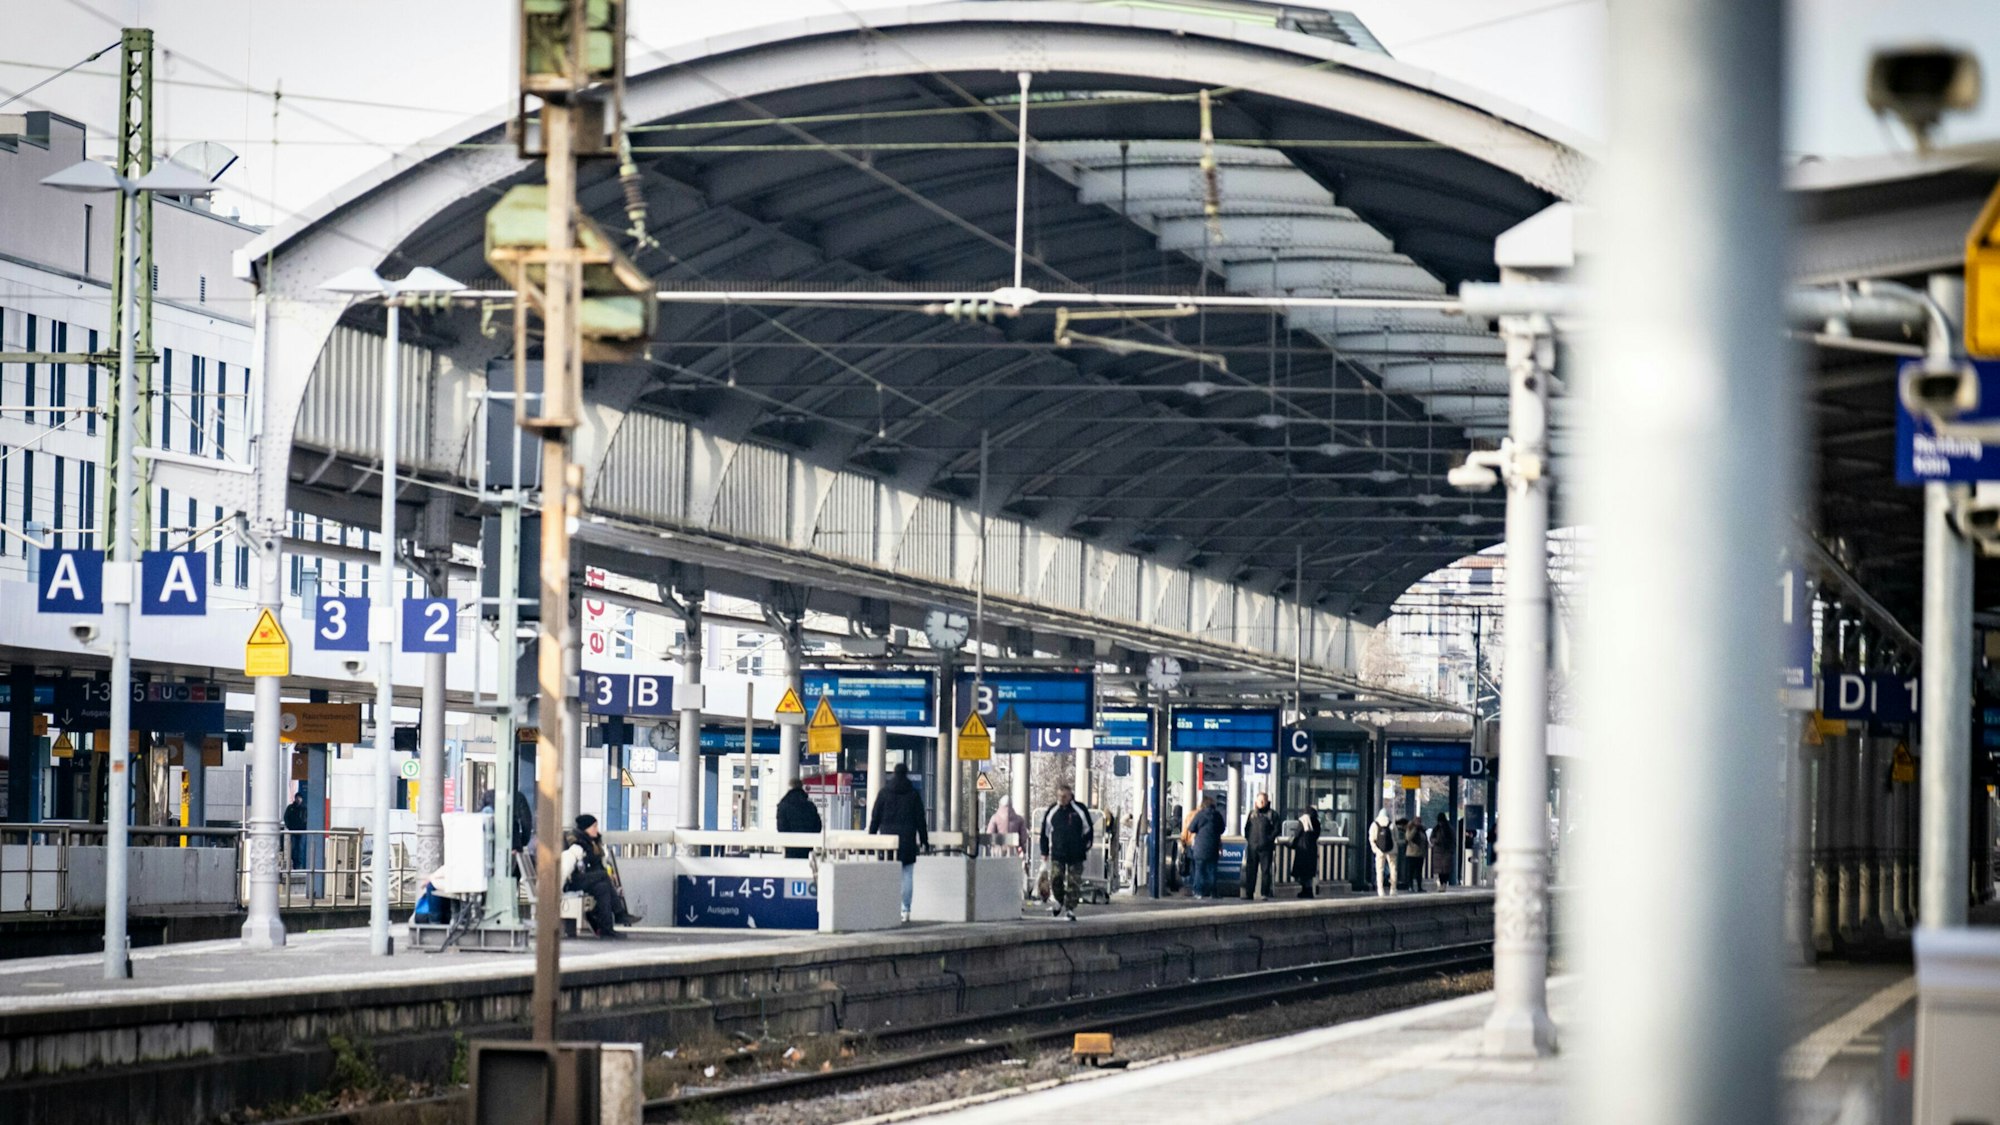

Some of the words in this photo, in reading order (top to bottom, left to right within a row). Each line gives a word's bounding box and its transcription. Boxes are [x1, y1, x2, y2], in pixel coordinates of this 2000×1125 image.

[46, 553, 85, 600] A
[159, 555, 198, 602] A
[320, 600, 347, 640] 3
[424, 602, 450, 642] 2
[133, 683, 145, 702] 5
[162, 686, 173, 700] U
[597, 676, 613, 706] 3
[637, 677, 659, 707] B
[838, 689, 870, 698] Remagen
[1839, 674, 1866, 711] D
[1904, 677, 1918, 712] 1
[1044, 728, 1061, 747] C
[1291, 731, 1308, 752] C
[1257, 752, 1269, 770] 3
[1470, 757, 1484, 775] D
[1222, 849, 1241, 857] Bonn
[707, 877, 716, 897] 1
[738, 878, 775, 899] 4-5
[793, 881, 805, 896] U
[707, 905, 740, 916] Ausgang
